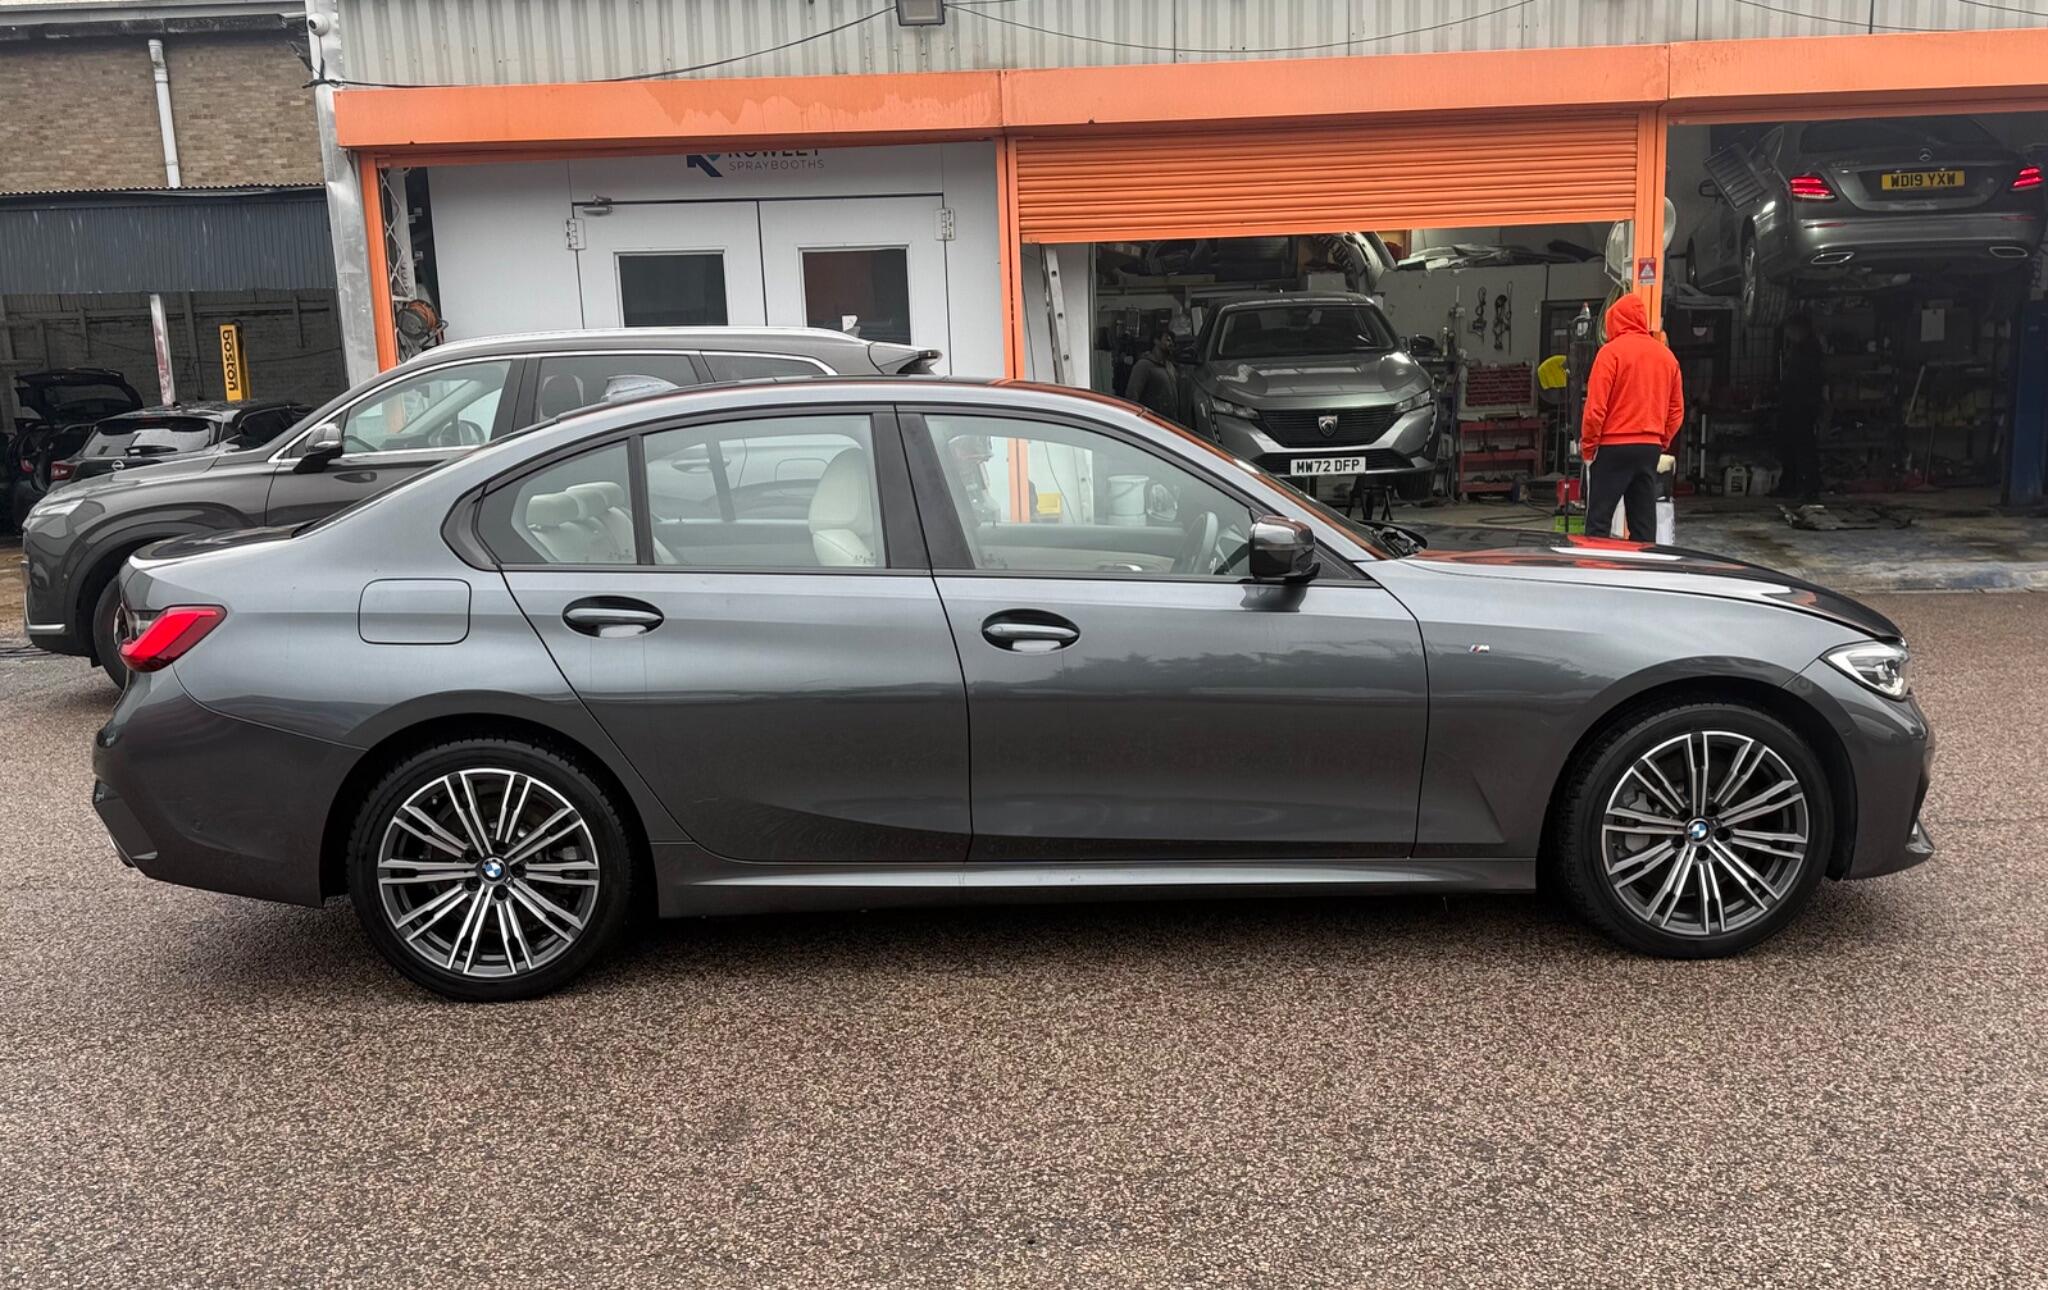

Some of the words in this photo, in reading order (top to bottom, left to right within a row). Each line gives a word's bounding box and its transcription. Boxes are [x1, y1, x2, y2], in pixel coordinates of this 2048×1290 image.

[728, 159, 825, 171] SPRAYBOOTHS
[1891, 174, 1923, 187] WD19
[1928, 172, 1956, 186] YXW
[223, 330, 238, 391] boston
[1296, 460, 1331, 473] MW72
[1334, 459, 1360, 472] DFP
